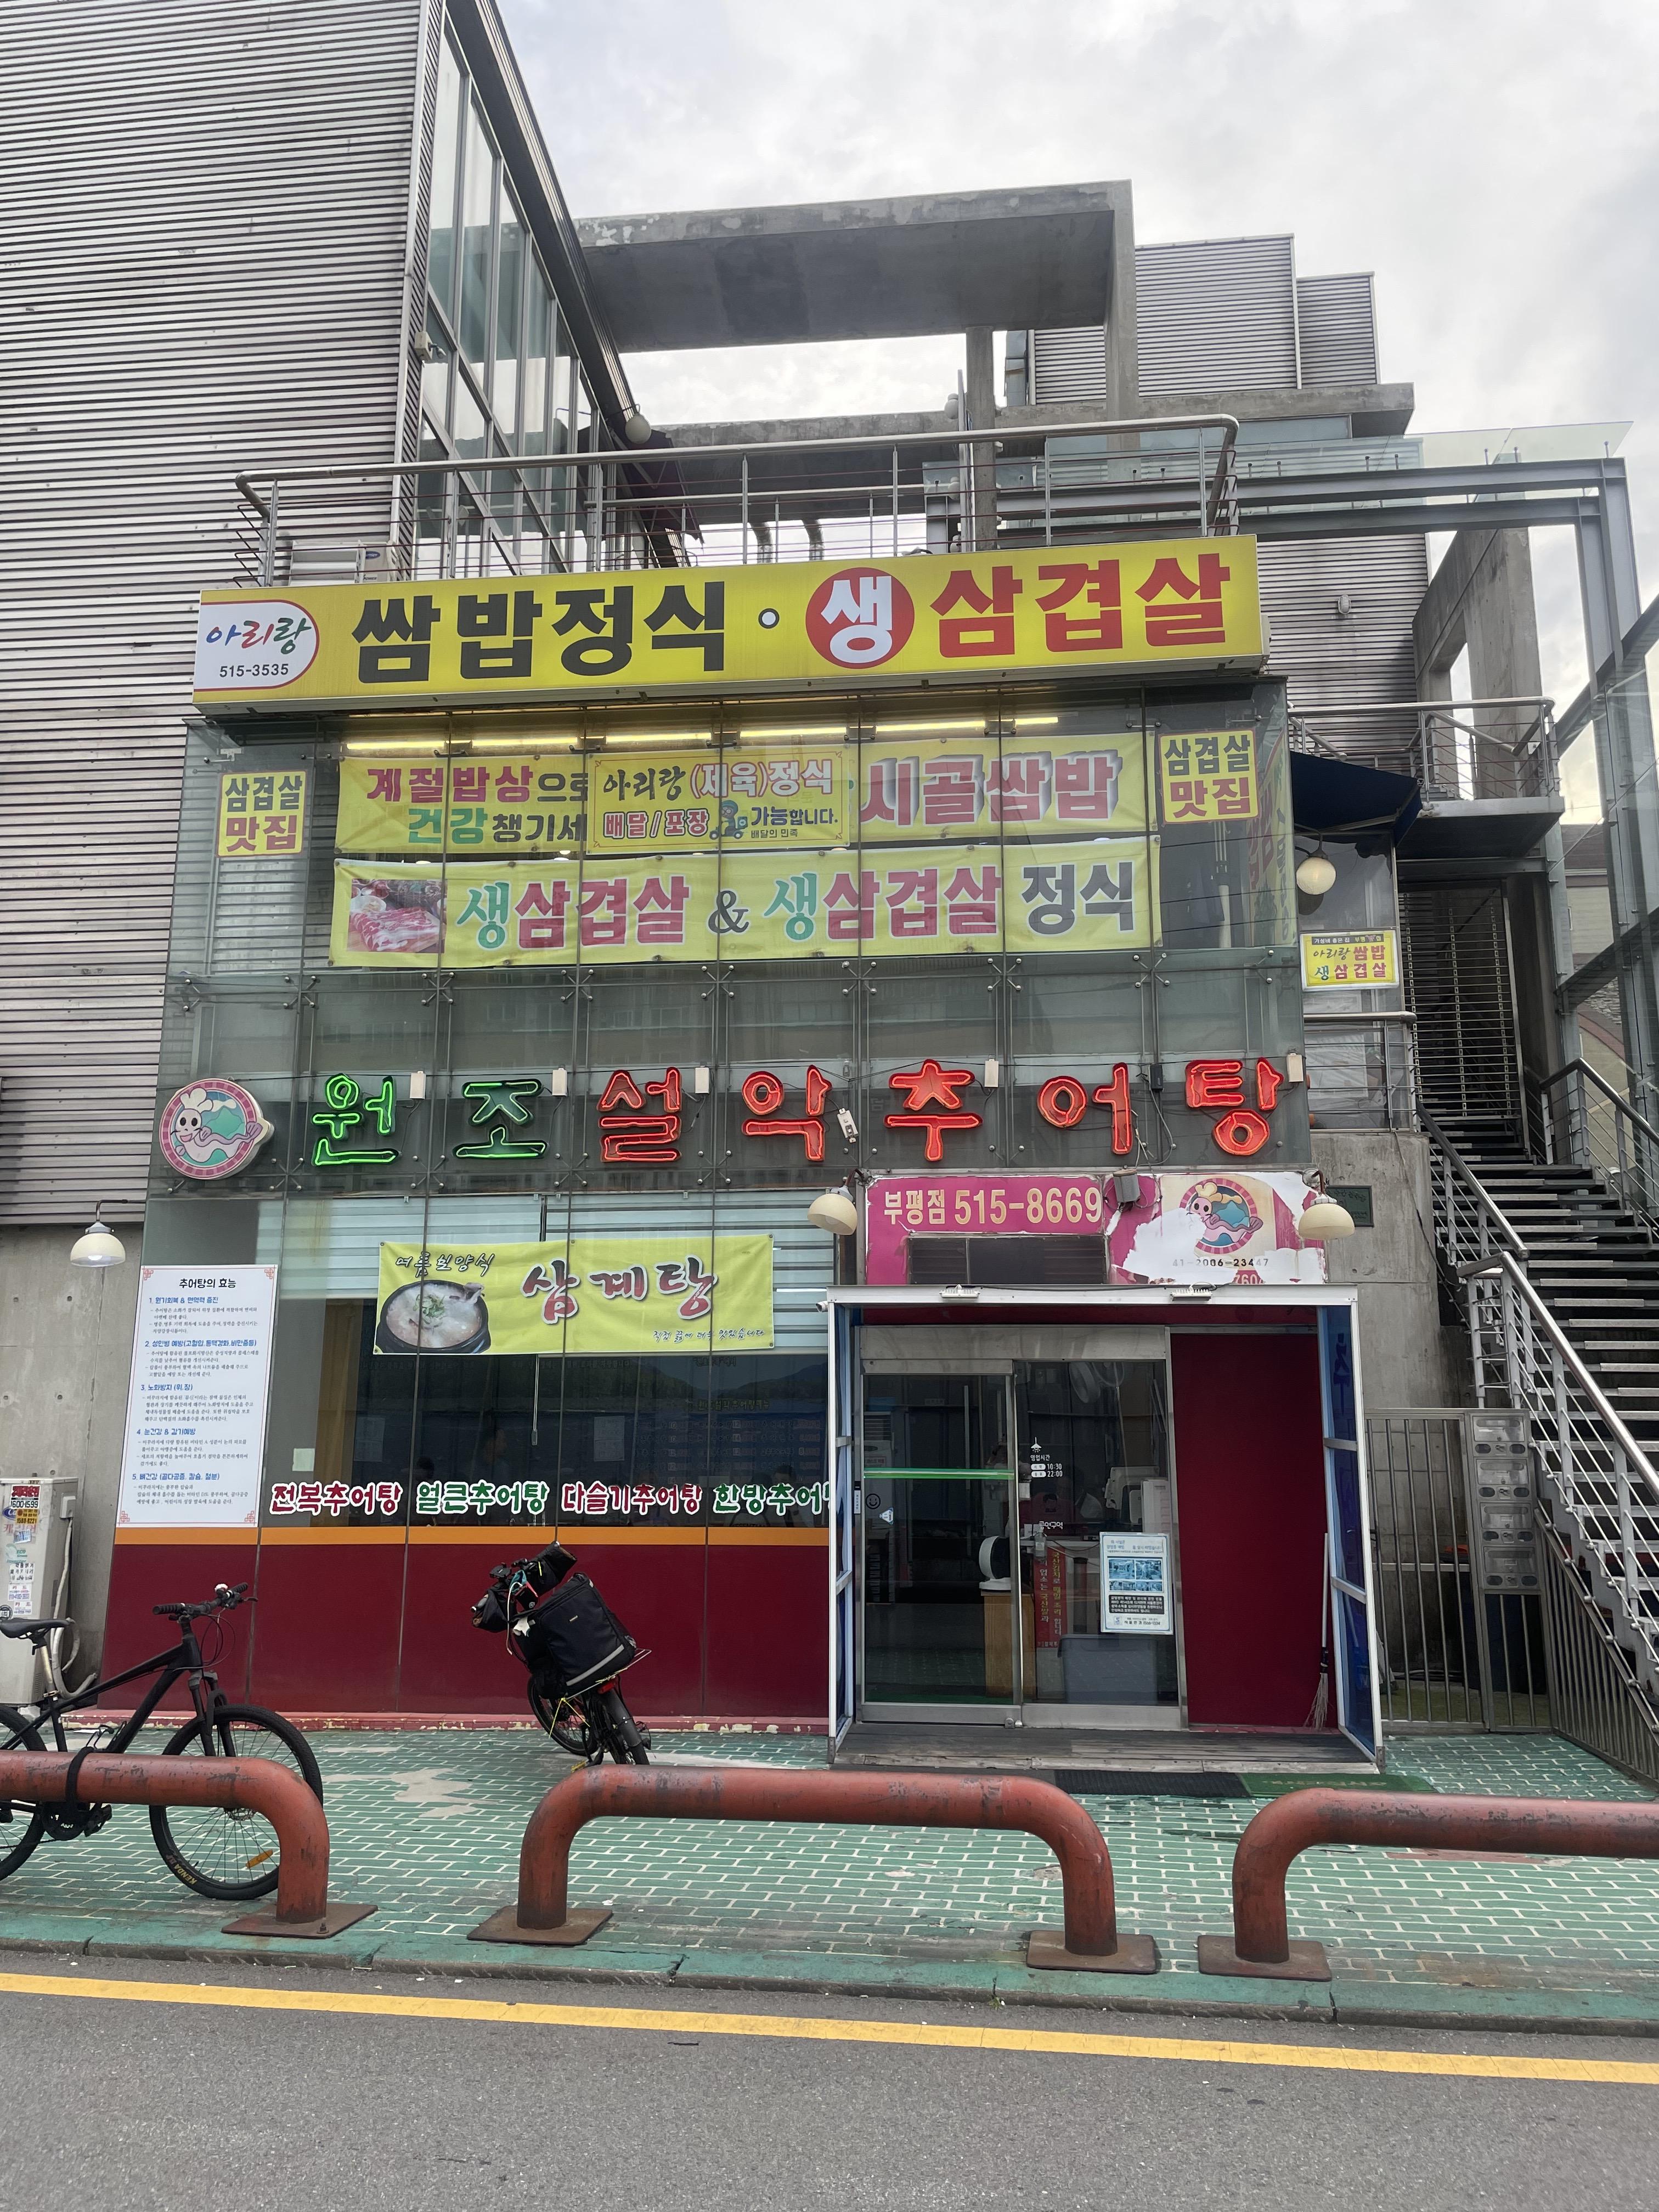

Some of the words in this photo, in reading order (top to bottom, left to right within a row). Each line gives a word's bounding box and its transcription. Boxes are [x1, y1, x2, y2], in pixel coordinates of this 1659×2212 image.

[206, 618, 312, 656] 아리랑
[352, 581, 725, 684] 쌈밥정식
[219, 663, 289, 678] 515-3535
[1163, 733, 1251, 776] 삼겹살
[224, 770, 303, 811] 삼겹살
[603, 765, 686, 802] 아리랑
[690, 759, 833, 799] (제육)정식
[861, 754, 1118, 827] 시골쌈밥
[1171, 777, 1250, 819] 맛집
[225, 815, 298, 852] 맛집
[408, 807, 488, 845] 건강
[751, 806, 838, 827] 가능합니다.
[751, 829, 777, 839] 배달의
[780, 828, 798, 838] 민족
[455, 874, 690, 951] 생삼겹살
[709, 889, 749, 934] &
[764, 864, 1002, 942] 생삼겹살
[1022, 861, 1135, 935] 정식
[1313, 947, 1351, 960] 아리랑
[1353, 945, 1386, 961] 쌈밥
[1314, 962, 1387, 980] 생삼겹살
[311, 1073, 547, 1167] 원조
[883, 1188, 946, 1226] 부평점
[955, 1187, 1101, 1226] 515-8669
[179, 1278, 216, 1288] 추어탕의
[218, 1278, 236, 1288] 효능
[520, 1253, 720, 1324] 삼계탕
[653, 1330, 672, 1342] 직접
[718, 1327, 765, 1340] 맛있습니다
[269, 1481, 404, 1516] 전복추어탕
[415, 1478, 550, 1516] 얼큰추어탕
[560, 1481, 704, 1516] 다슬기추어탕
